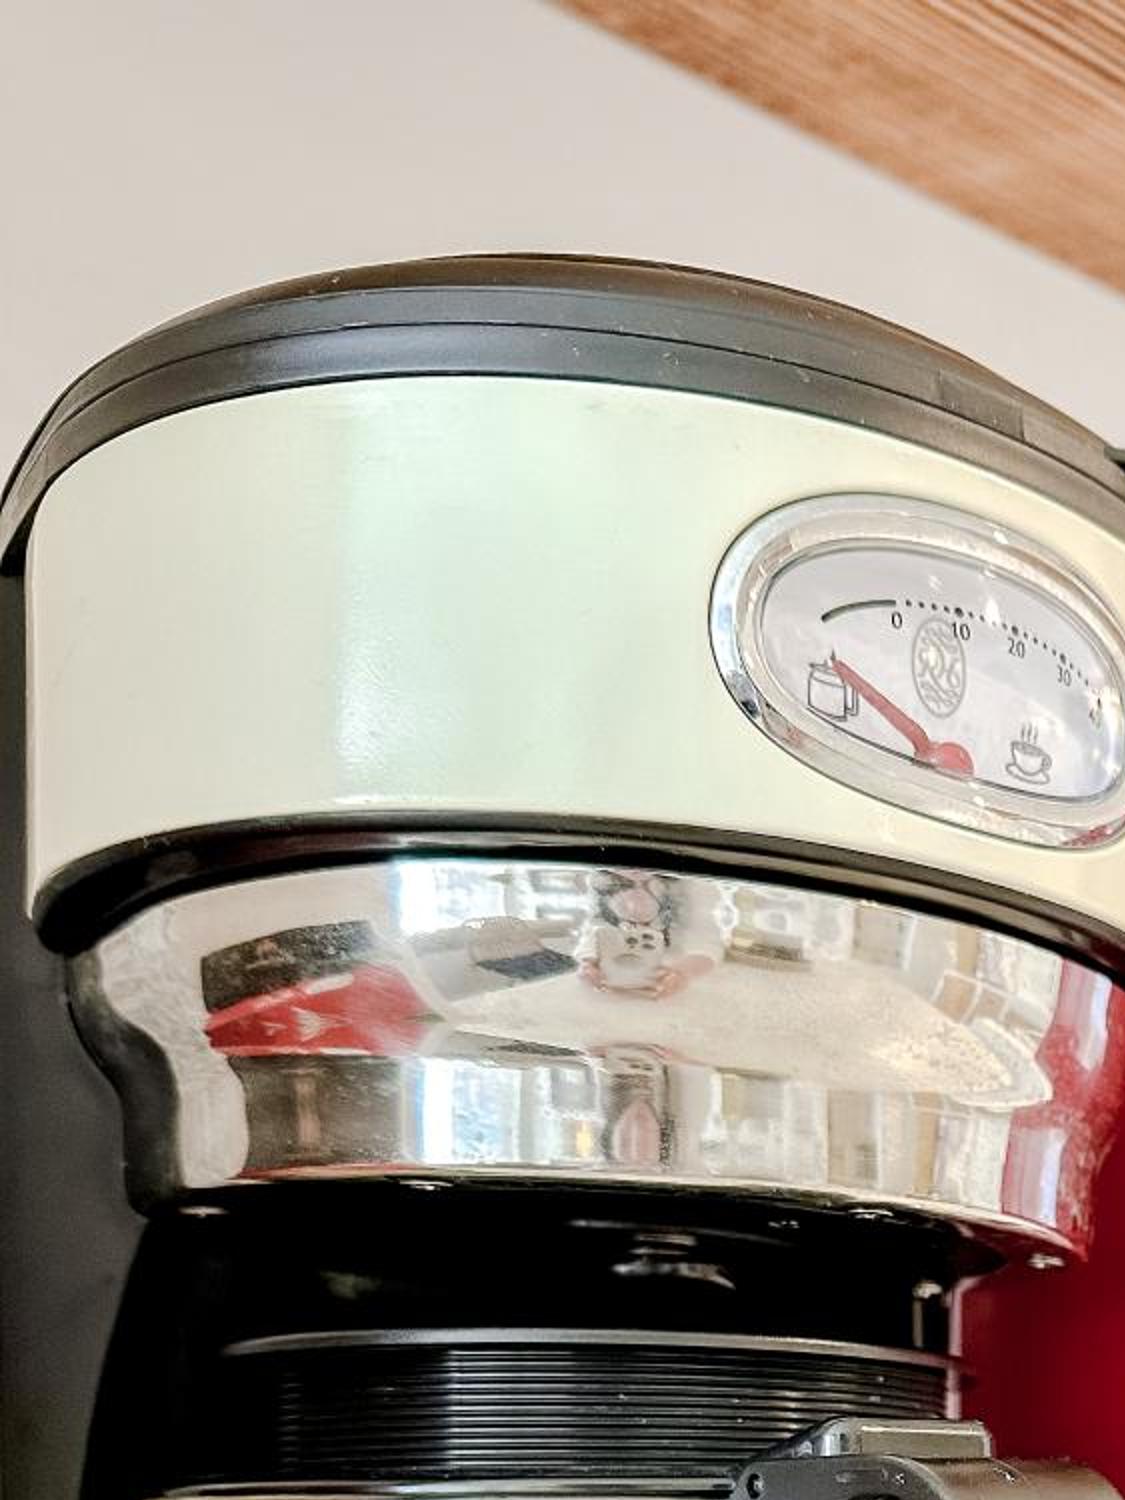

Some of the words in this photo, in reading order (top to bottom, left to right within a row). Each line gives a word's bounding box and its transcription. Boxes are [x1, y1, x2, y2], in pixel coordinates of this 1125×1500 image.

[891, 611, 903, 630] 0
[952, 621, 971, 641] 10
[1008, 637, 1025, 658] 20
[1057, 664, 1072, 687] 30
